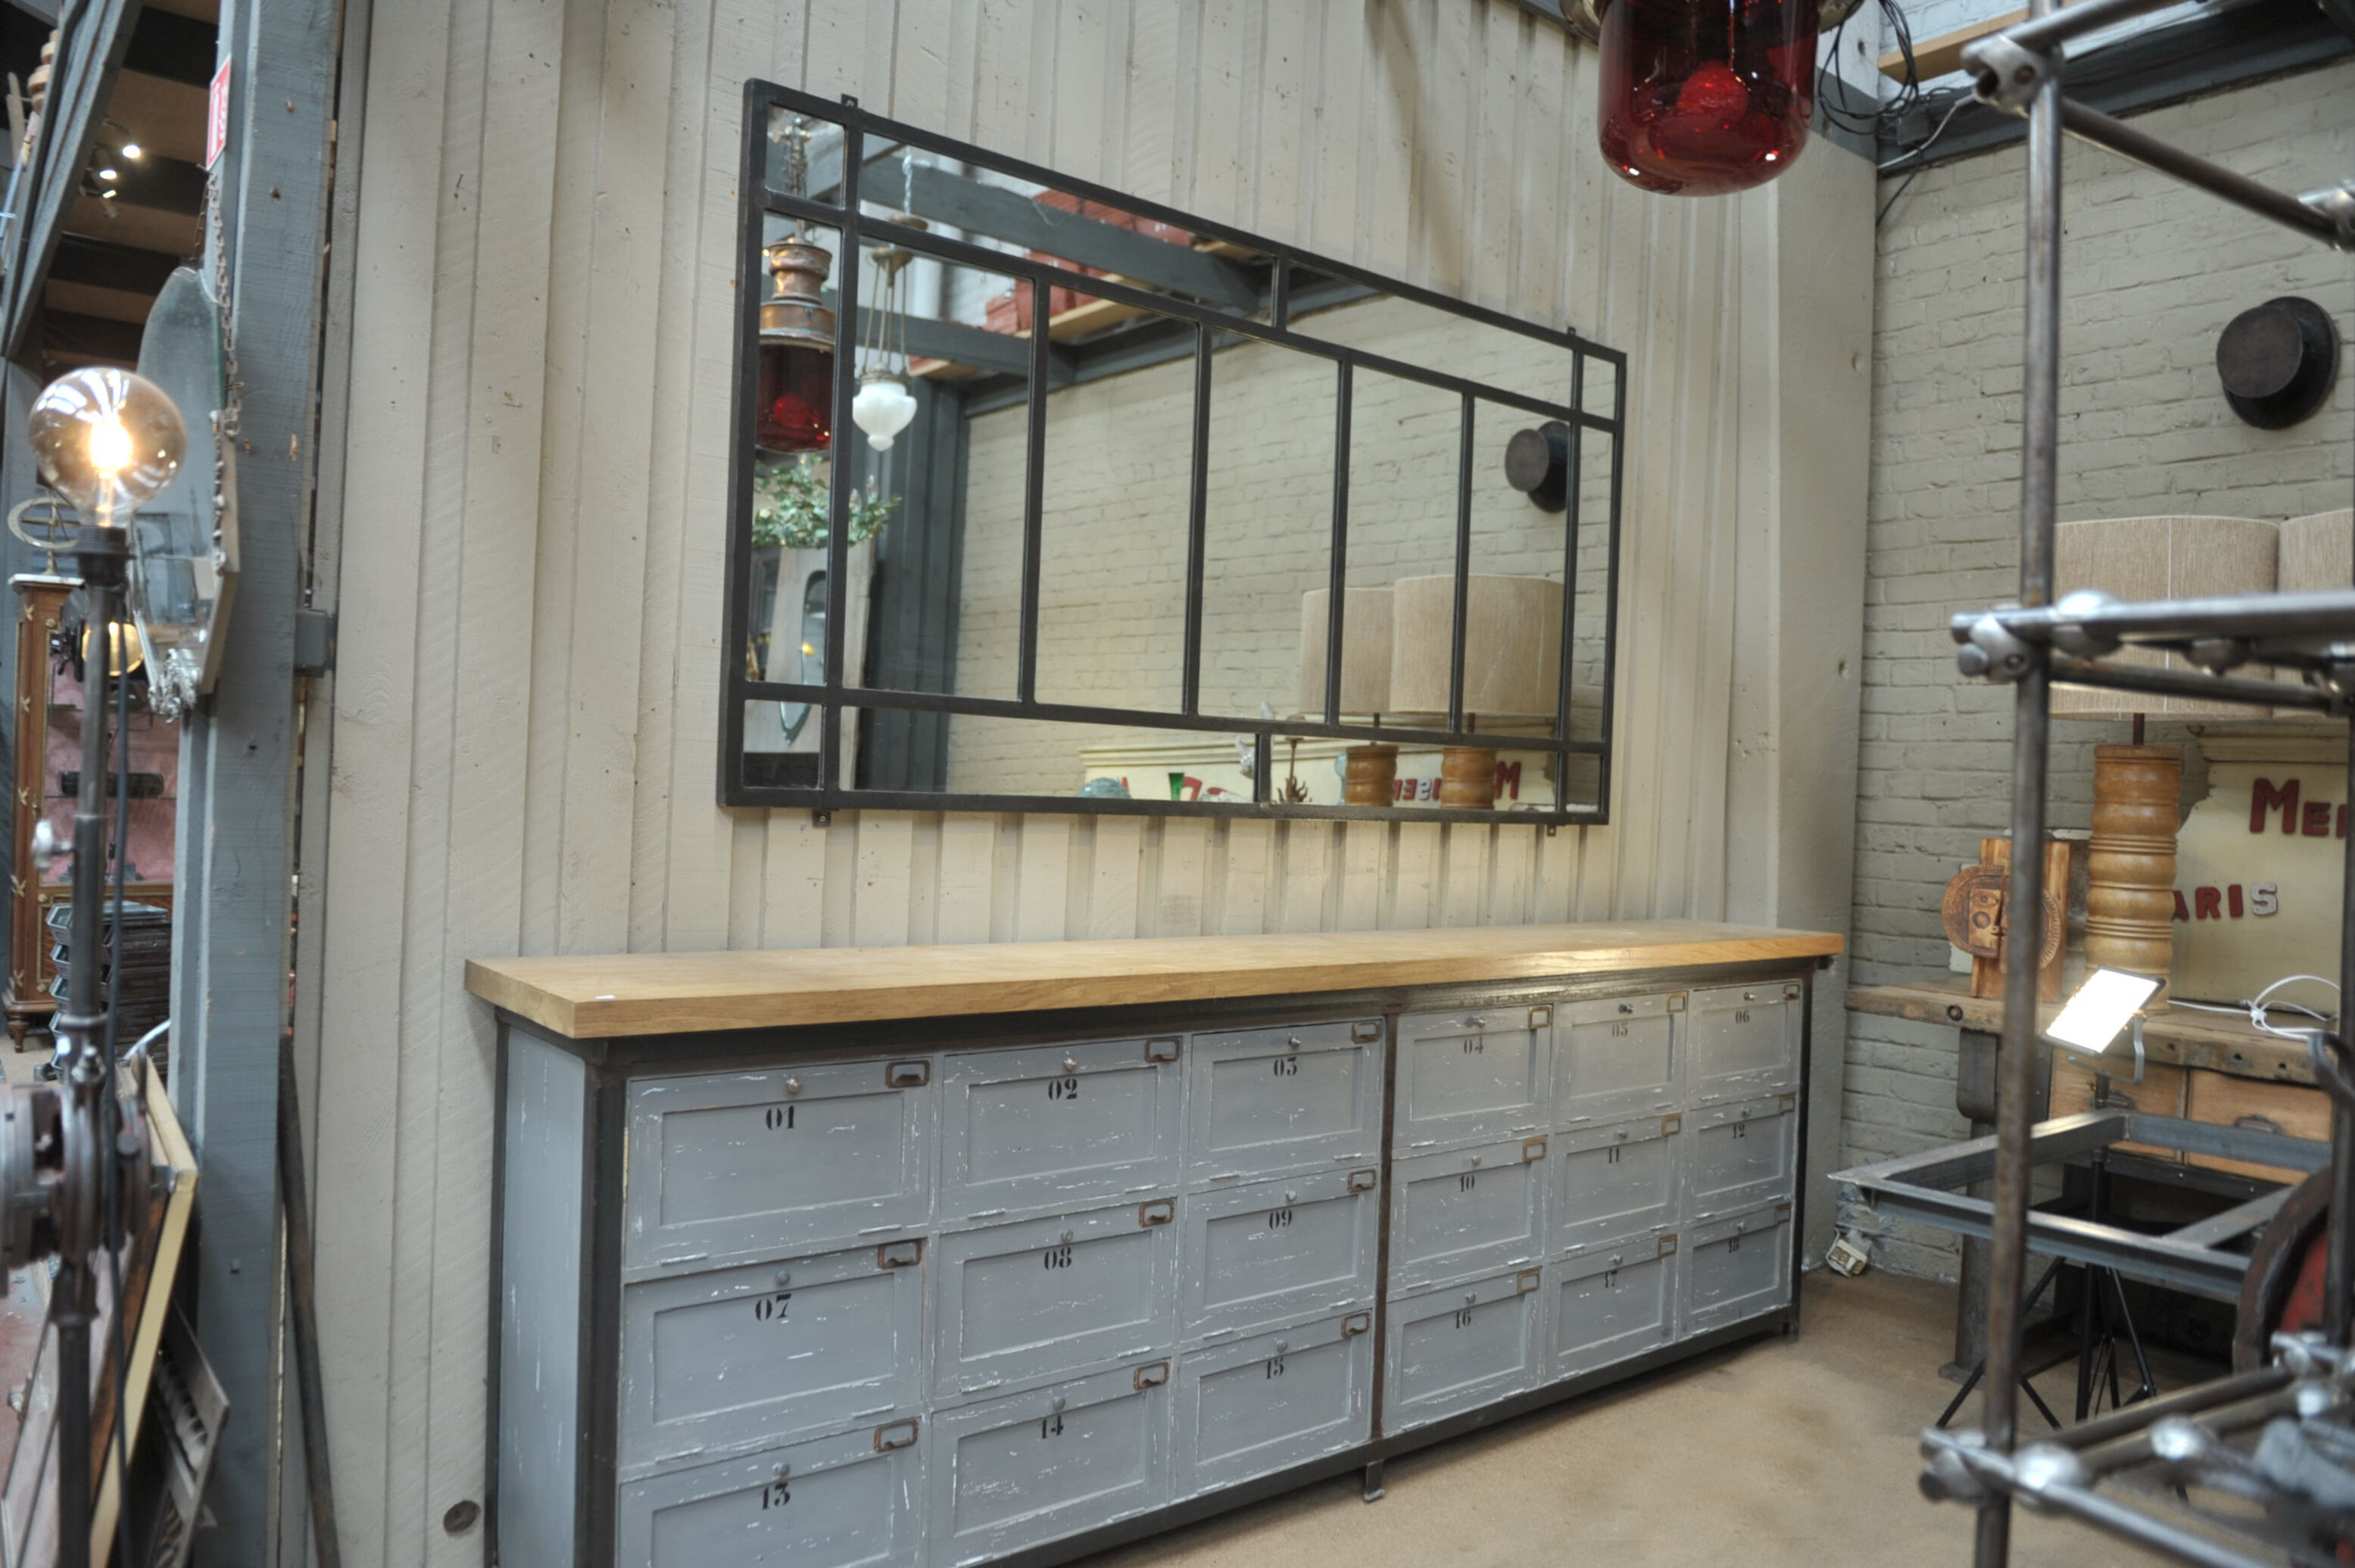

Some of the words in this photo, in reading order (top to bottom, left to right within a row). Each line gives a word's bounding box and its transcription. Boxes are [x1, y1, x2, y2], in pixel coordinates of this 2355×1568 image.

[1735, 1010, 1750, 1024] 06
[1611, 1022, 1628, 1038] 05
[1463, 1036, 1485, 1055] 04
[1274, 1056, 1298, 1077] 03
[1048, 1078, 1078, 1101] 02
[766, 1105, 795, 1130] 01
[1732, 1124, 1745, 1139] 12
[1606, 1147, 1620, 1164] 11
[1459, 1174, 1475, 1192] 10
[1268, 1208, 1293, 1230] 09
[1727, 1238, 1740, 1252] 18
[1043, 1246, 1072, 1270] 08
[1604, 1271, 1618, 1288] 17
[755, 1293, 792, 1322] 07
[1455, 1310, 1472, 1329] 16
[1264, 1358, 1284, 1379] 15
[1039, 1414, 1064, 1439] 14
[759, 1482, 791, 1510] 13
